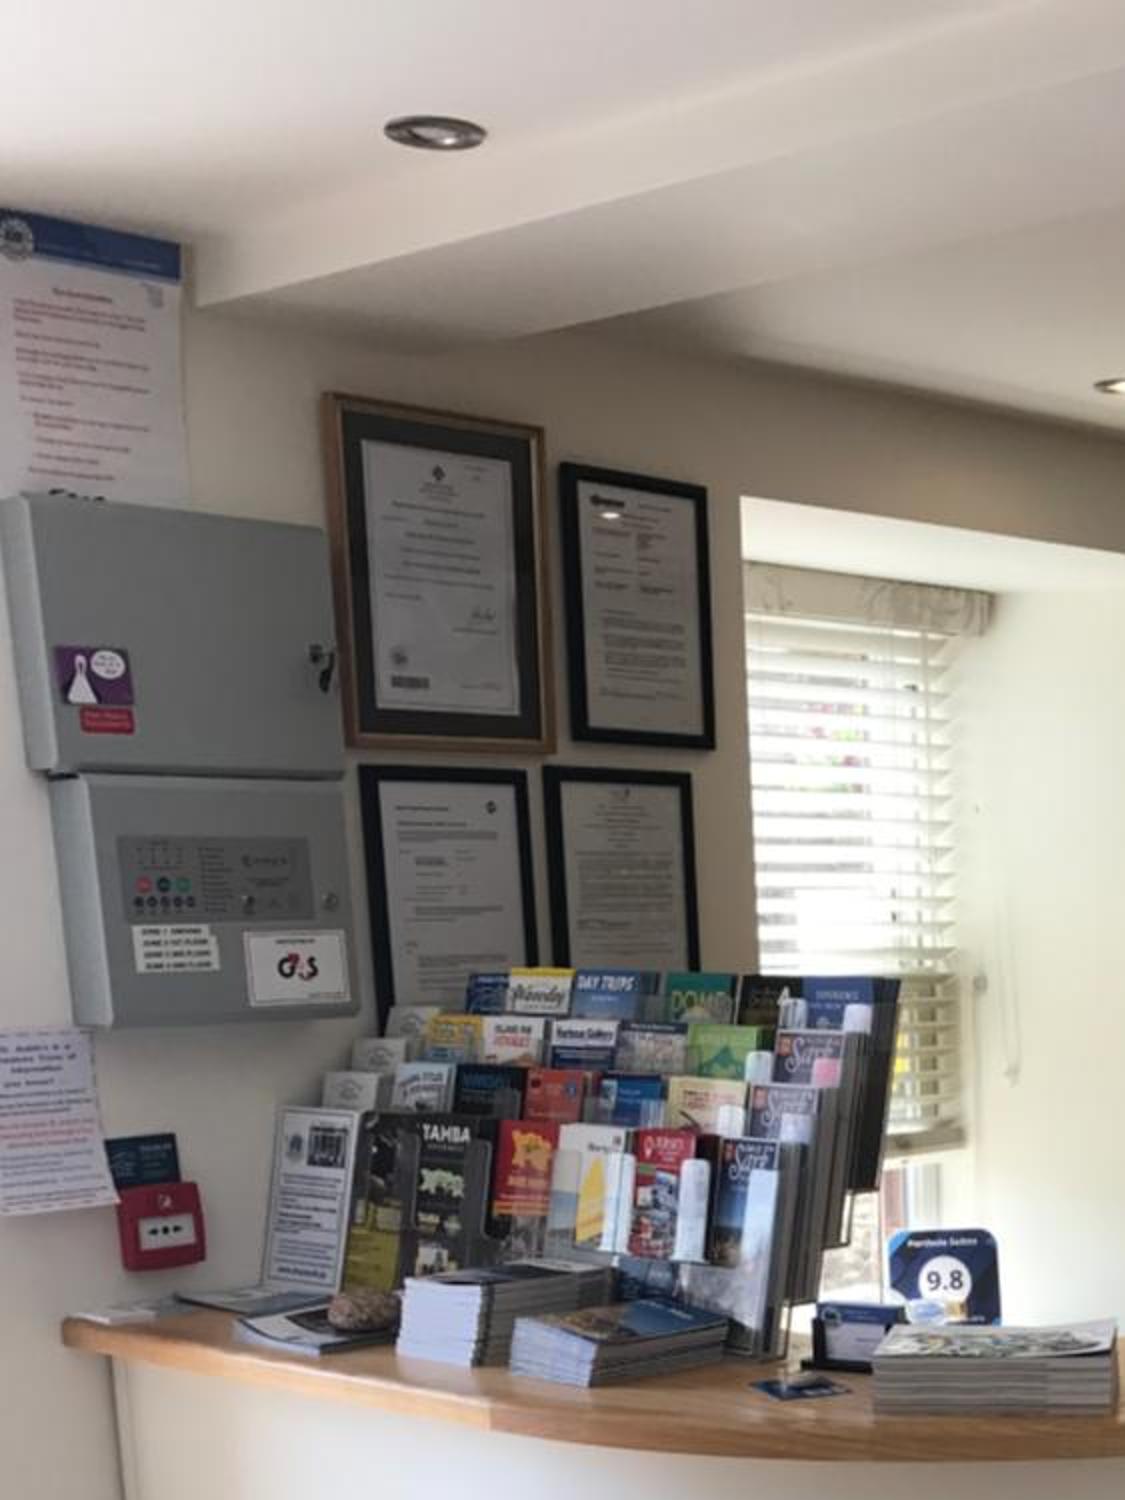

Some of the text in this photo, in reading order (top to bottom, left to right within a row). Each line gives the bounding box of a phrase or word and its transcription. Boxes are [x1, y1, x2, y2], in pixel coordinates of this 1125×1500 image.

[577, 974, 634, 991] DAY TRIPS
[422, 1123, 471, 1144] TAMBA
[926, 1269, 964, 1291] 9.8
